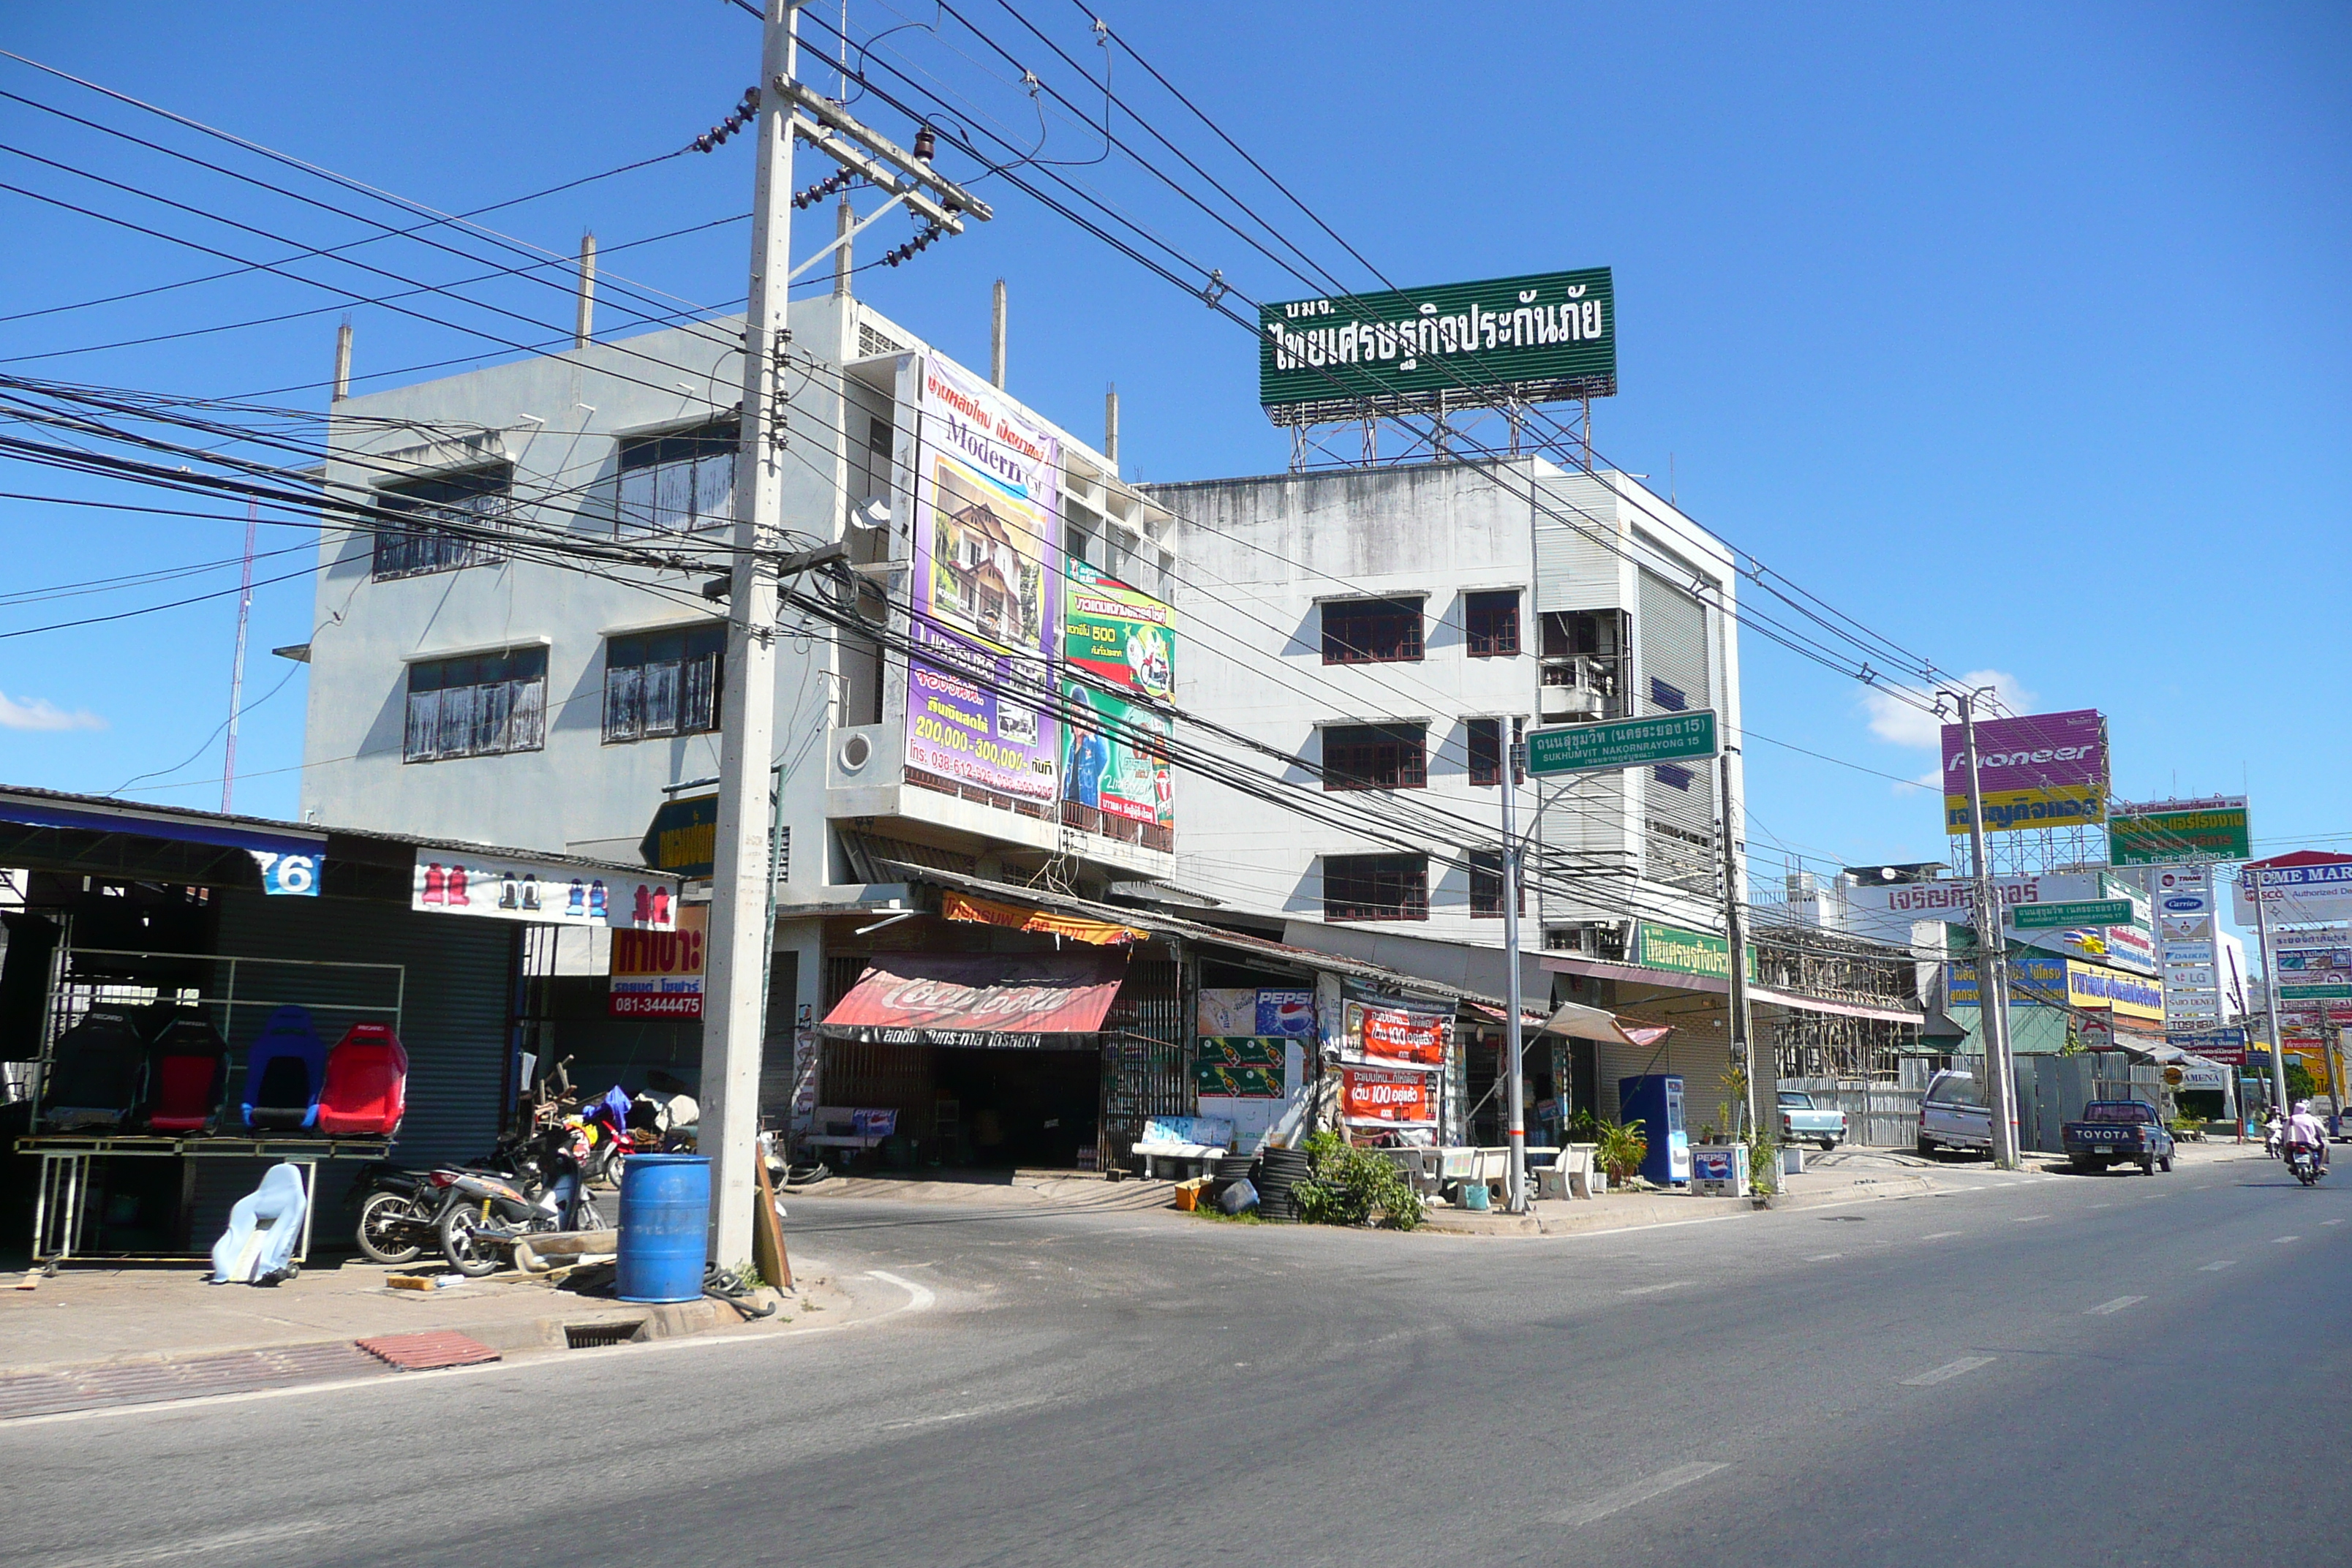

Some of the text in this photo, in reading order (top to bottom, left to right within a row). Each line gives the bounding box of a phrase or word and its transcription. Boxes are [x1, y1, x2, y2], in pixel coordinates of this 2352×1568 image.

[1285, 298, 1335, 317] บมจ.
[1268, 284, 1603, 372] ไทยเศรษฐกิจประกันภัย
[946, 412, 1022, 483] Modern
[1092, 625, 1116, 644] 500
[927, 695, 989, 734] คืนเงินสดให้
[1537, 717, 1705, 752] ถนนสุขุมวิท (นครระยอง 15)
[910, 738, 927, 764] โทร.
[1543, 736, 1700, 762] SUKHUMVIT NAKORNRAYONG 15
[1031, 756, 1053, 776] ทันที
[2261, 889, 2283, 899] SCG
[2293, 888, 2337, 897] Authorized
[2168, 900, 2198, 909] Carrier
[614, 979, 655, 992] รถยนต์
[2190, 973, 2206, 983] LG
[616, 997, 700, 1013] 081-3444475
[1258, 992, 1313, 1005] PEPSI
[2171, 1020, 2216, 1029] TOSHIBA
[883, 1027, 918, 1044] สดชื่น
[1390, 1027, 1406, 1045] 100
[1407, 1030, 1435, 1049] อยู่แล้ว
[2185, 1074, 2219, 1082] AMENA
[1352, 1083, 1417, 1105] เต็ม 100 อยู่แล้ว
[2076, 1130, 2130, 1139] TOYOTA
[1696, 1154, 1727, 1162] PEPSI
